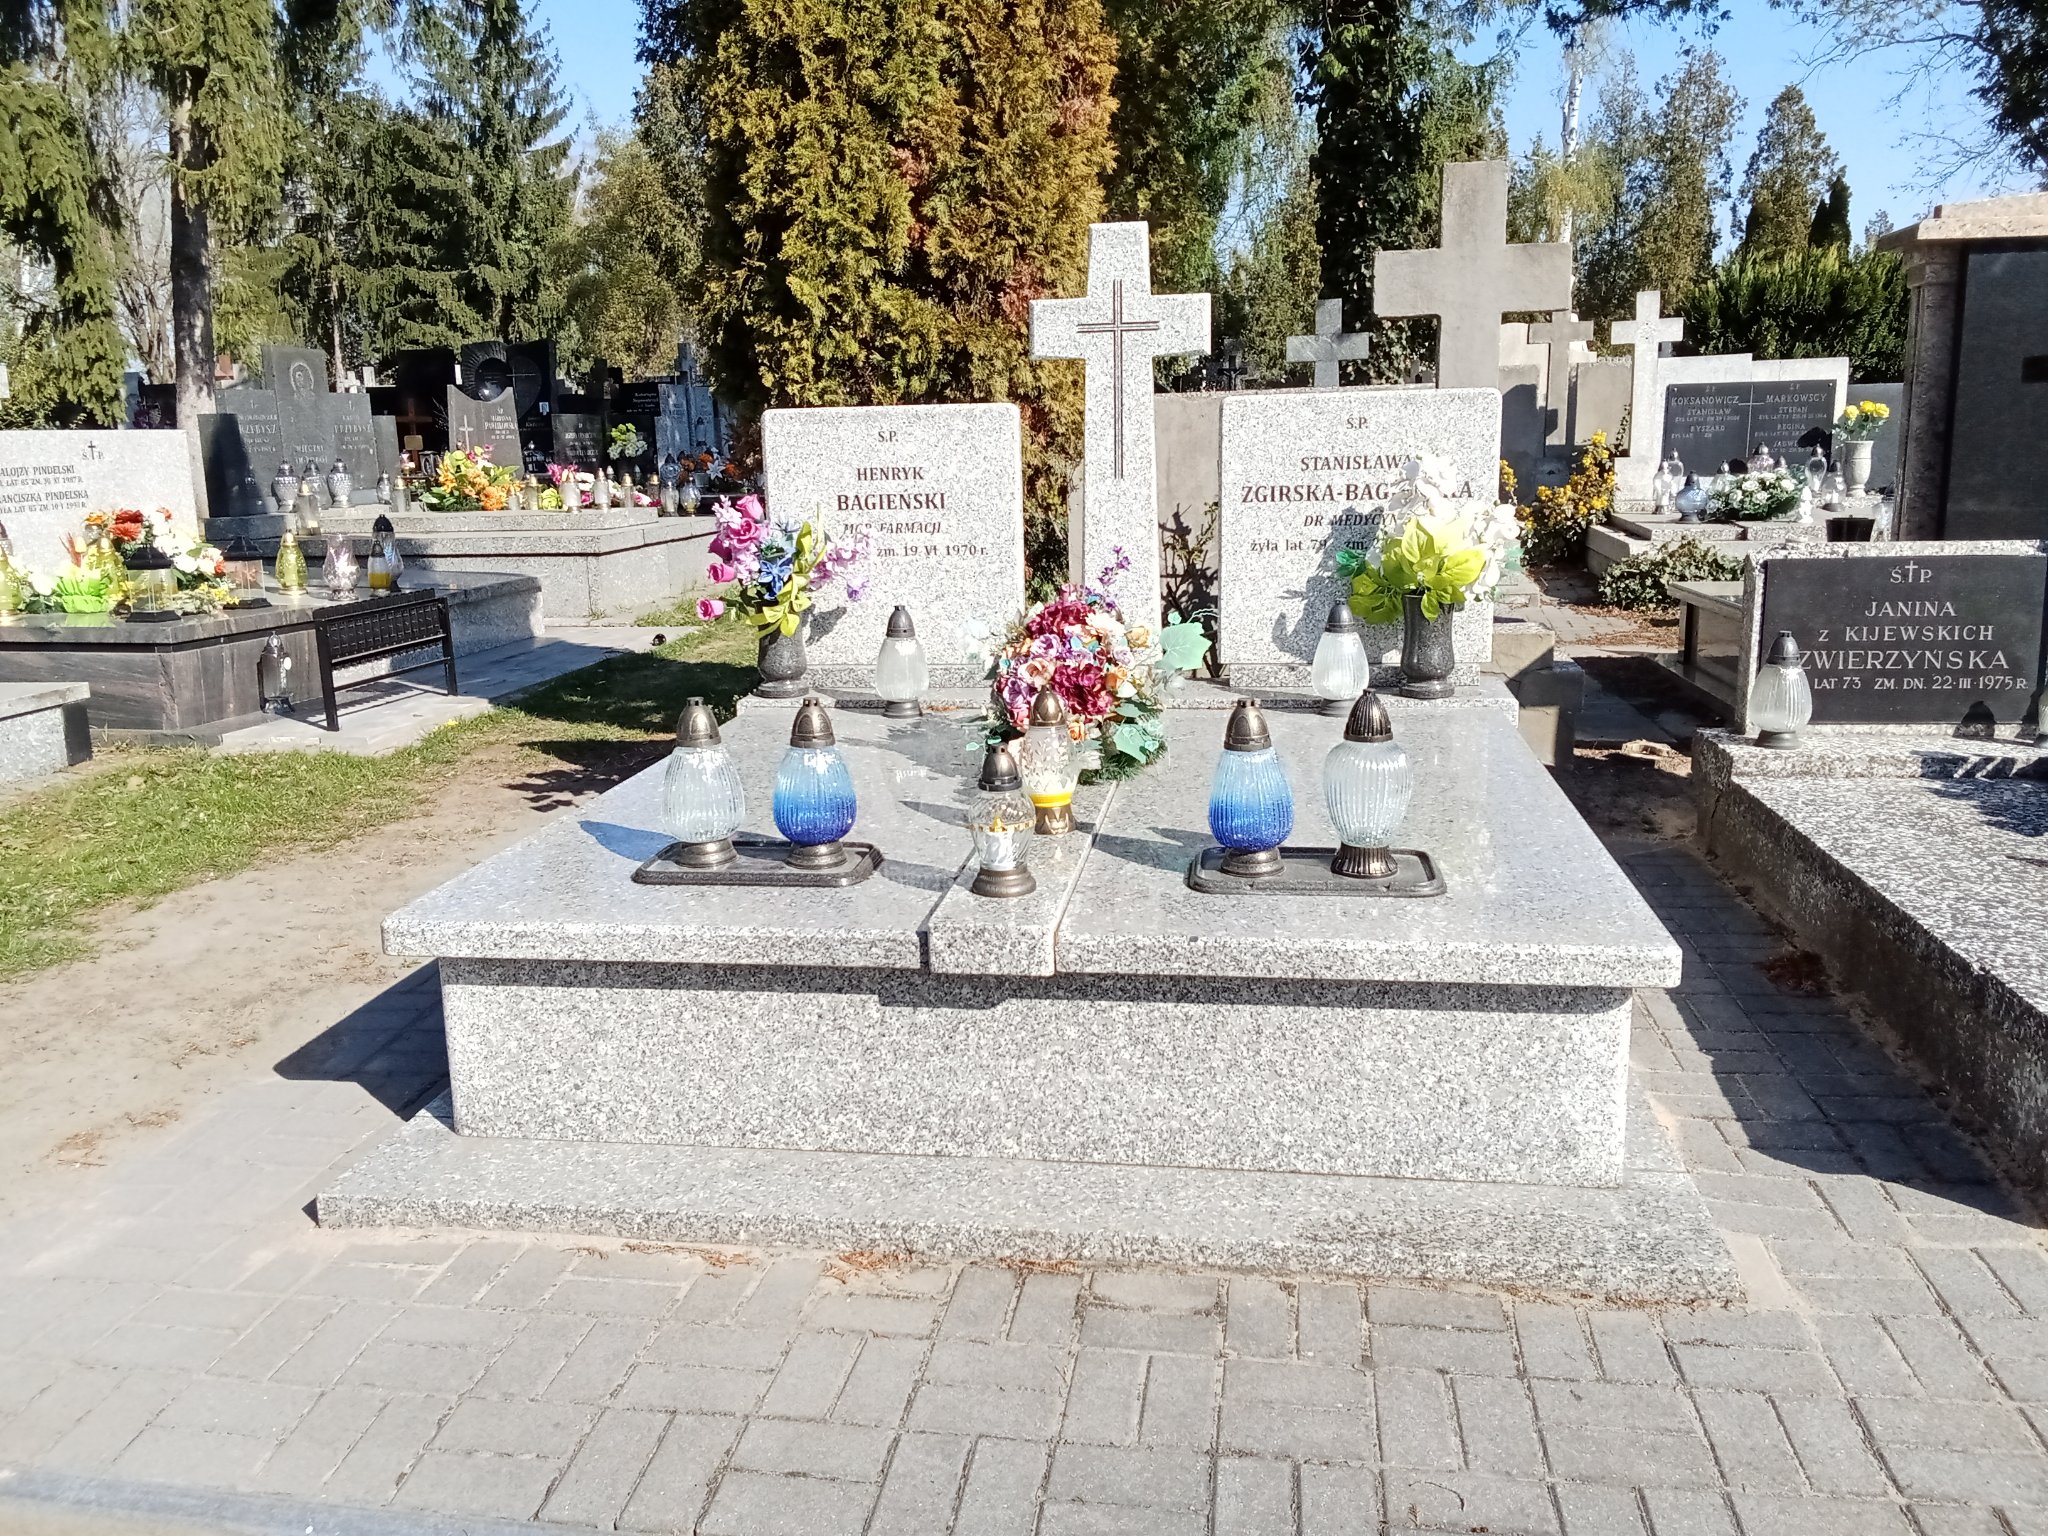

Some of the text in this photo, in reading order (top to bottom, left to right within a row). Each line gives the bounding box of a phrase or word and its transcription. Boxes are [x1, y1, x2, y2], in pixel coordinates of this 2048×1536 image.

[33, 464, 75, 475] PINDELSKI
[856, 466, 925, 481] HENRYK
[45, 489, 89, 502] PINDELSKA
[1242, 480, 1474, 502] ZGIRSKA-BAGA
[837, 488, 946, 511] BAGIEŃSKI
[1303, 513, 1398, 527] DR MEDYCYN
[877, 546, 899, 557] zm.
[904, 543, 919, 556] 19
[946, 544, 977, 556] 1970
[1250, 540, 1279, 553] żyła
[1285, 539, 1303, 551] lat
[1343, 541, 1369, 551] zm.
[1865, 601, 1957, 617] JANINA
[1845, 625, 1994, 642] KIJEWSKICH
[1799, 648, 2009, 670] ZWIERZYŃSKA
[1814, 678, 1838, 690] LAT
[1842, 676, 1862, 689] 73
[1873, 678, 1899, 690] ZM.
[1903, 677, 1928, 690] DN.
